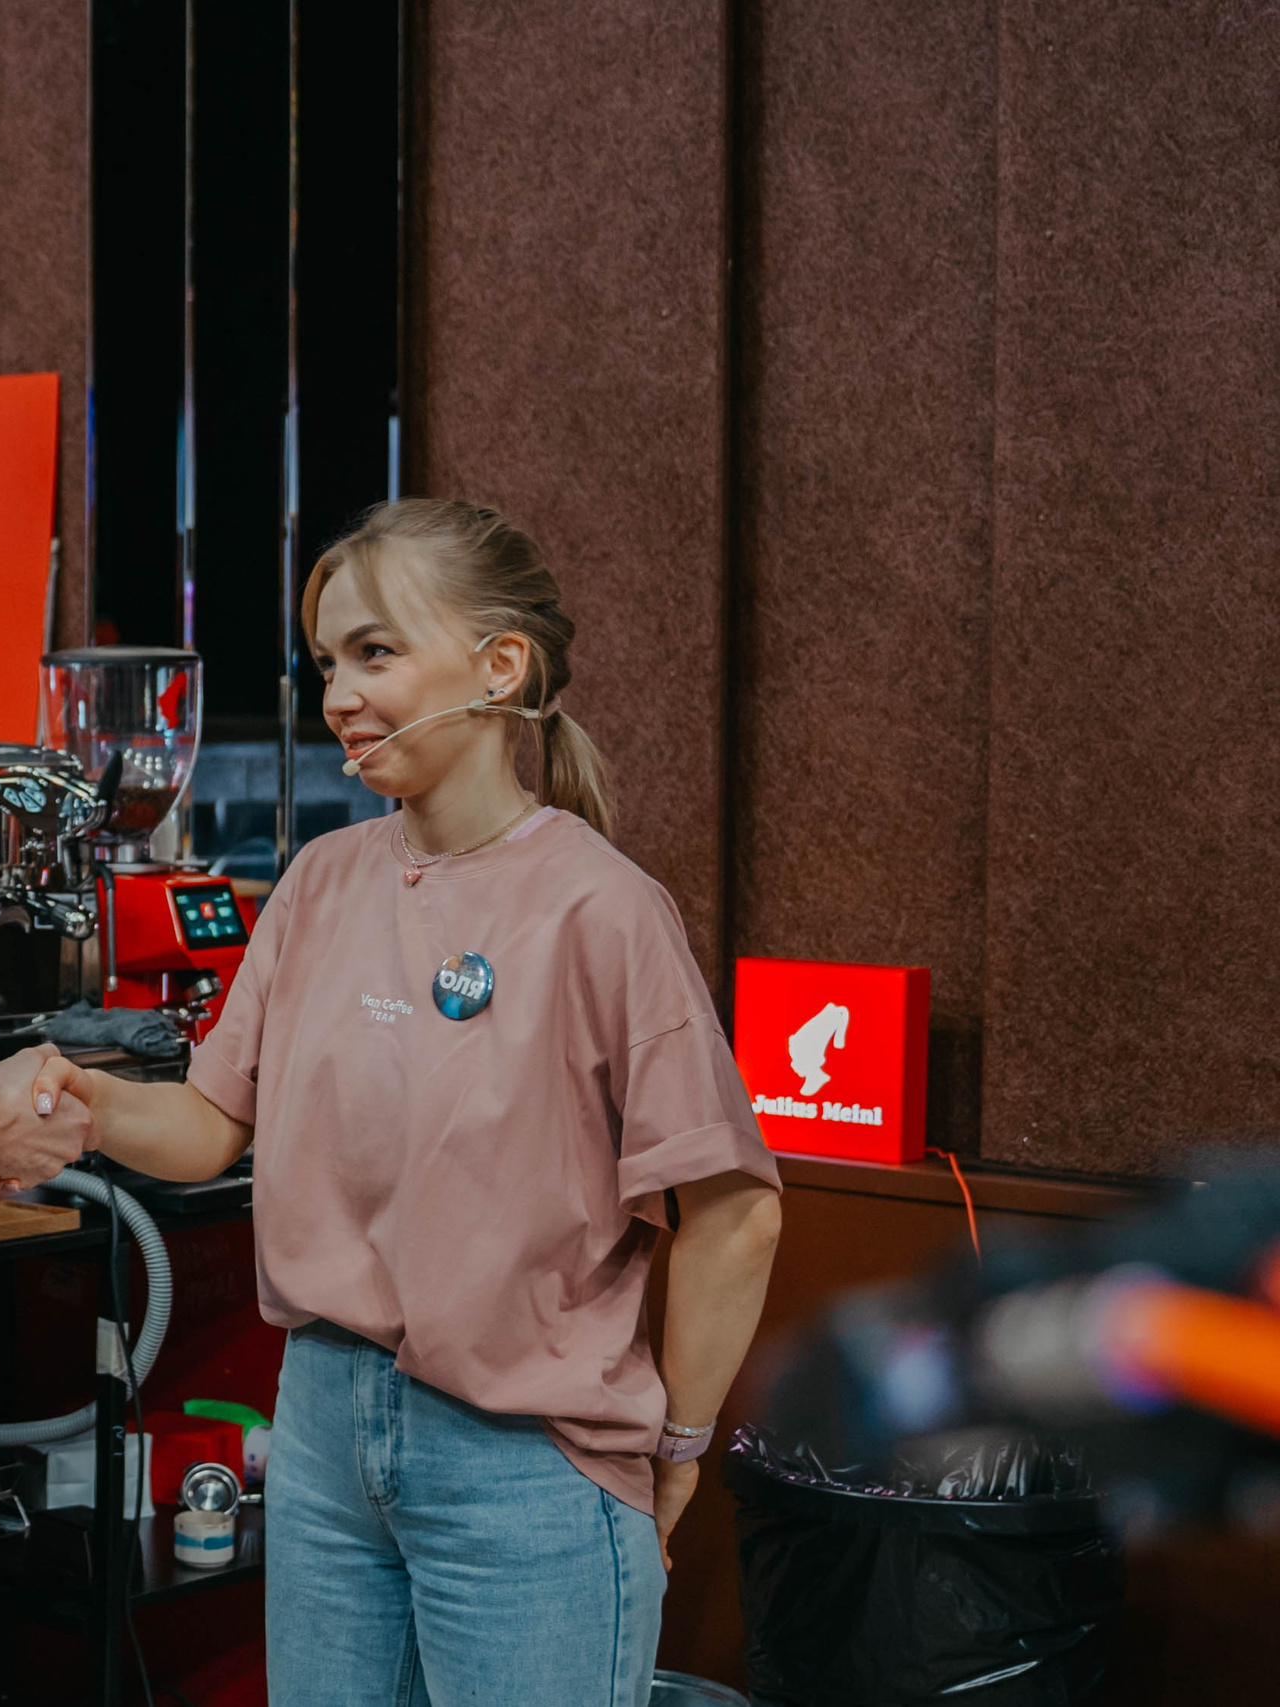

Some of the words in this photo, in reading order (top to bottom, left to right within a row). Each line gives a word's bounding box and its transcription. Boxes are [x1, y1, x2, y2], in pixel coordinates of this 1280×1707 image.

[439, 970, 485, 1000] ОЛЯ
[752, 1094, 818, 1119] Julius
[821, 1102, 883, 1126] Meinl
